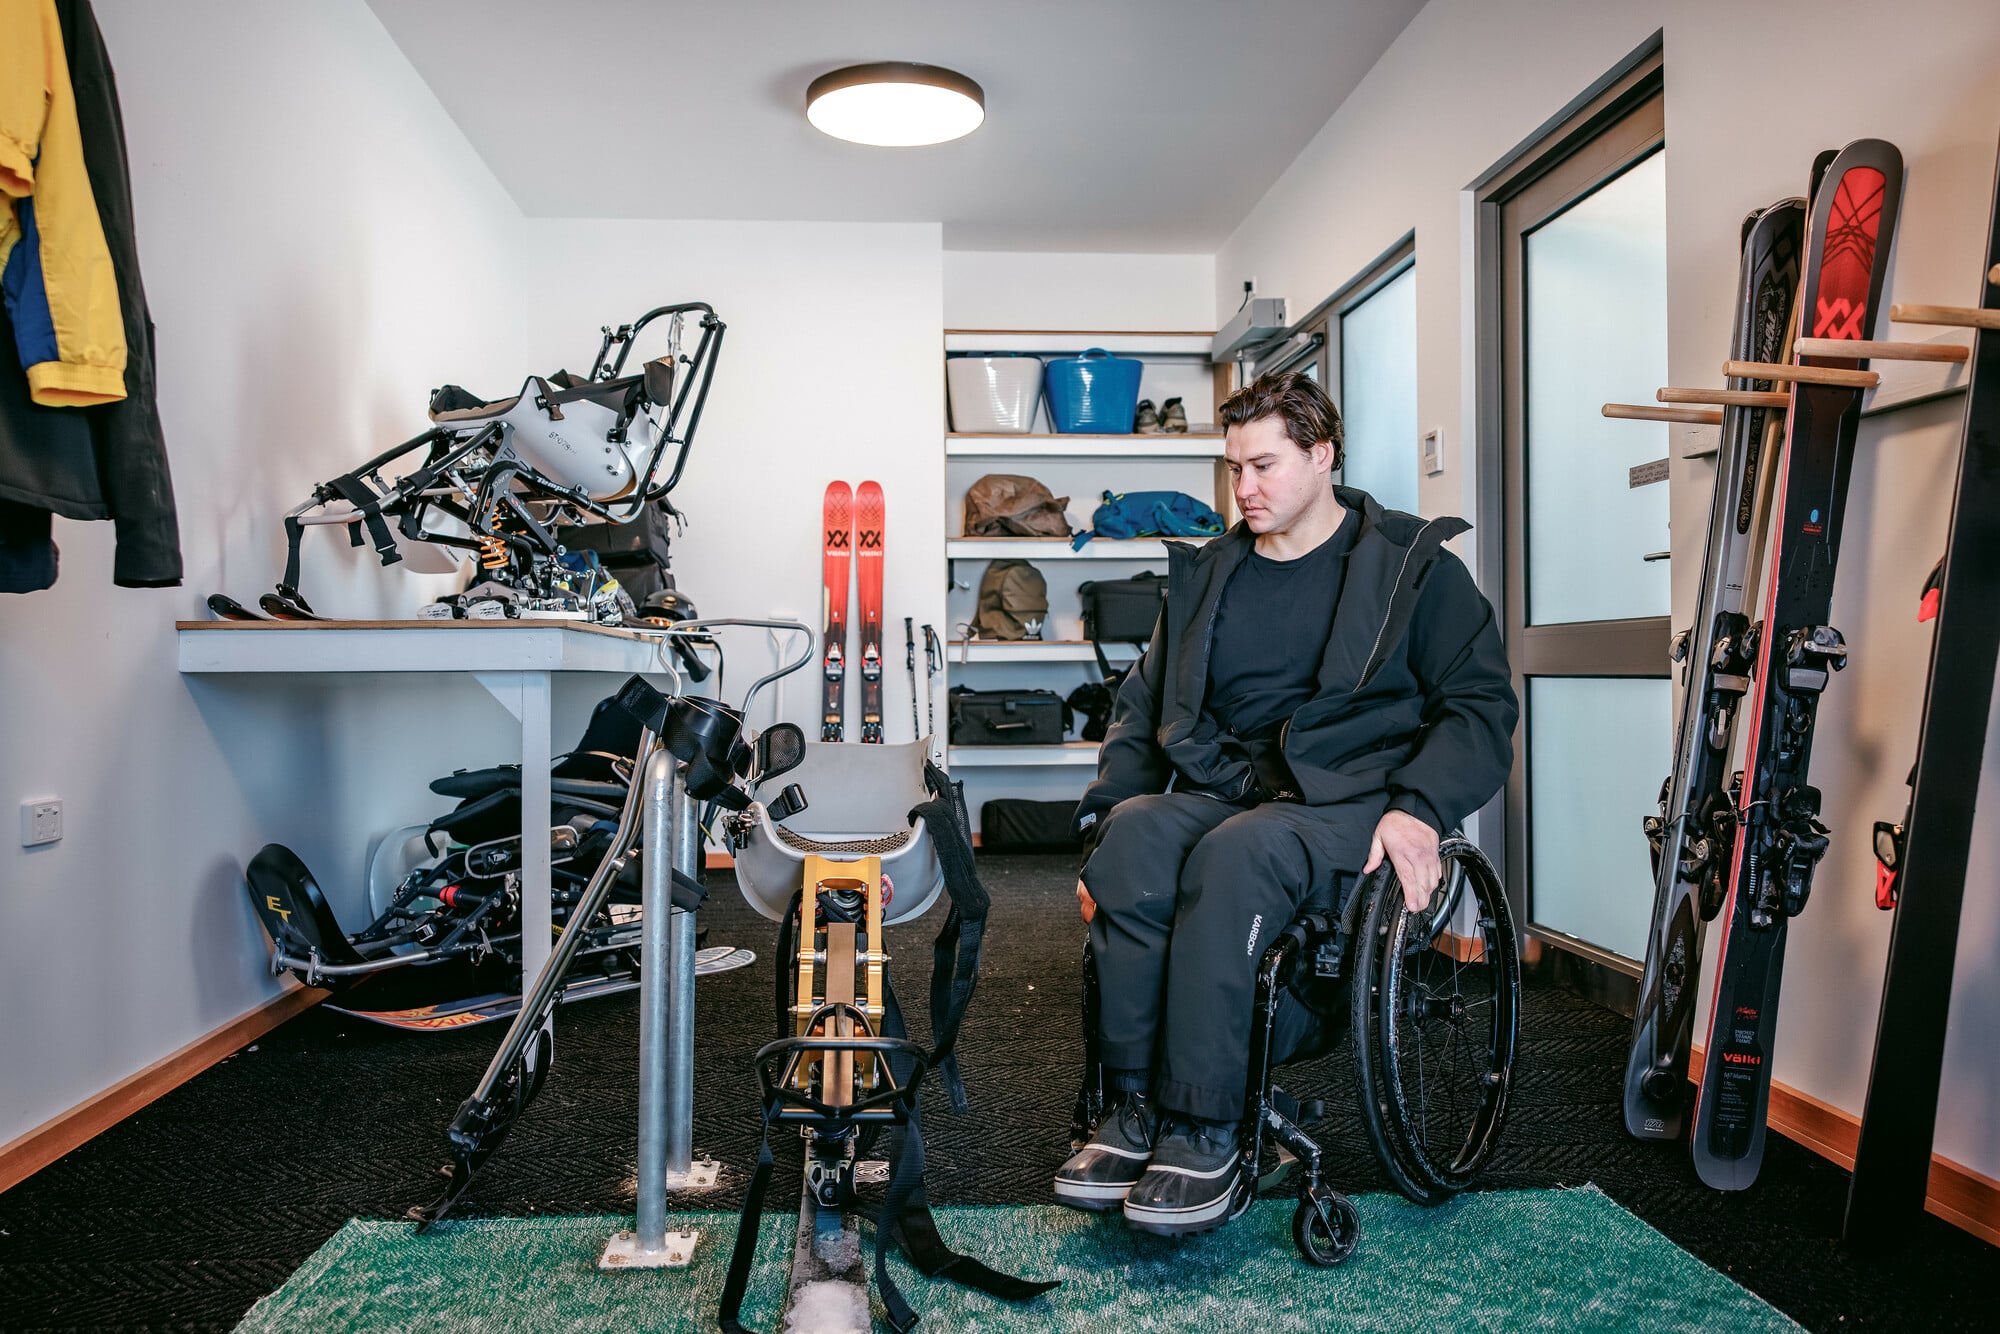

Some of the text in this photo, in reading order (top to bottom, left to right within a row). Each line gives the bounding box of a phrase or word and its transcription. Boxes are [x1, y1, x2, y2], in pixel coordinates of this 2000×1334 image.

[536, 475, 570, 493] Tempo
[266, 895, 292, 923] ET
[1247, 914, 1262, 956] KARBON
